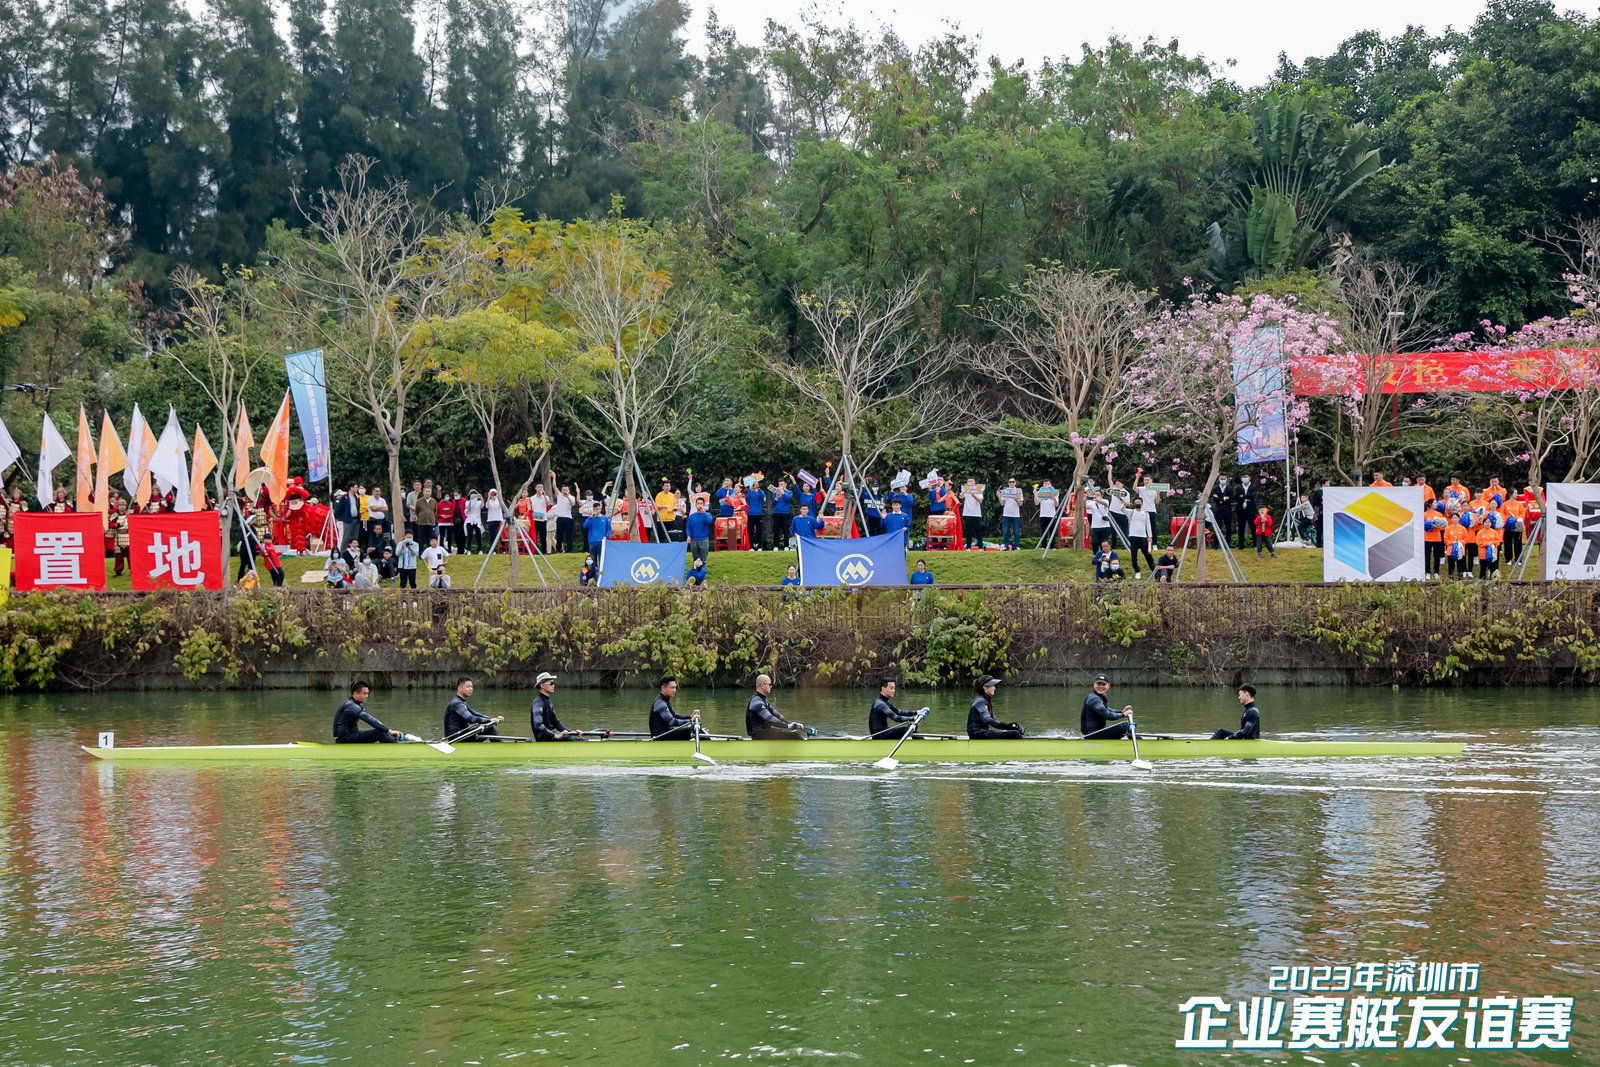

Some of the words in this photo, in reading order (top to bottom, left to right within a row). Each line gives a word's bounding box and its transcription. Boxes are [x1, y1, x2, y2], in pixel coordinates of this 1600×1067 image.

[33, 531, 88, 585] 置
[147, 531, 205, 586] 地
[103, 735, 108, 746] 1
